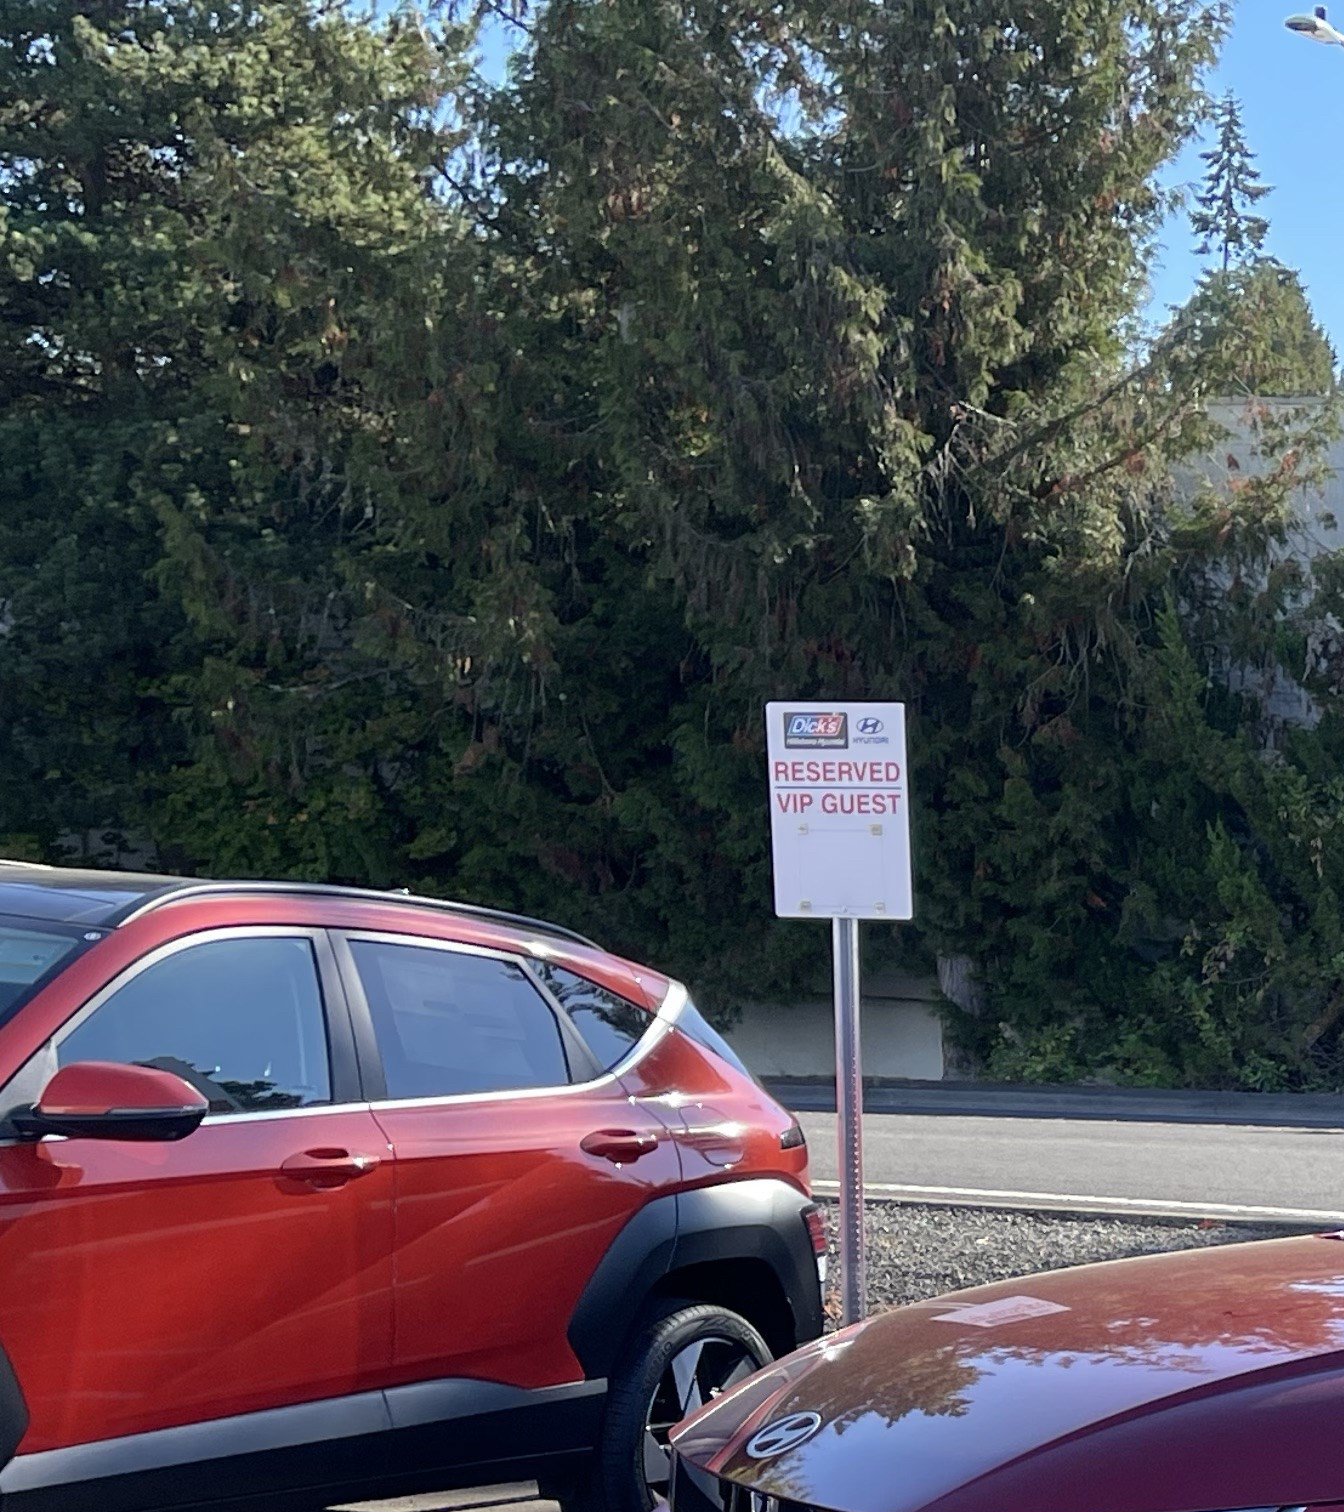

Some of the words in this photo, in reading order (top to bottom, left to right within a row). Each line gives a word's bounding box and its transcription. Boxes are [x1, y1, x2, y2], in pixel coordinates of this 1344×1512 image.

[775, 762, 900, 782] RESERVED
[777, 794, 813, 813] VIP
[821, 794, 901, 814] GUEST
